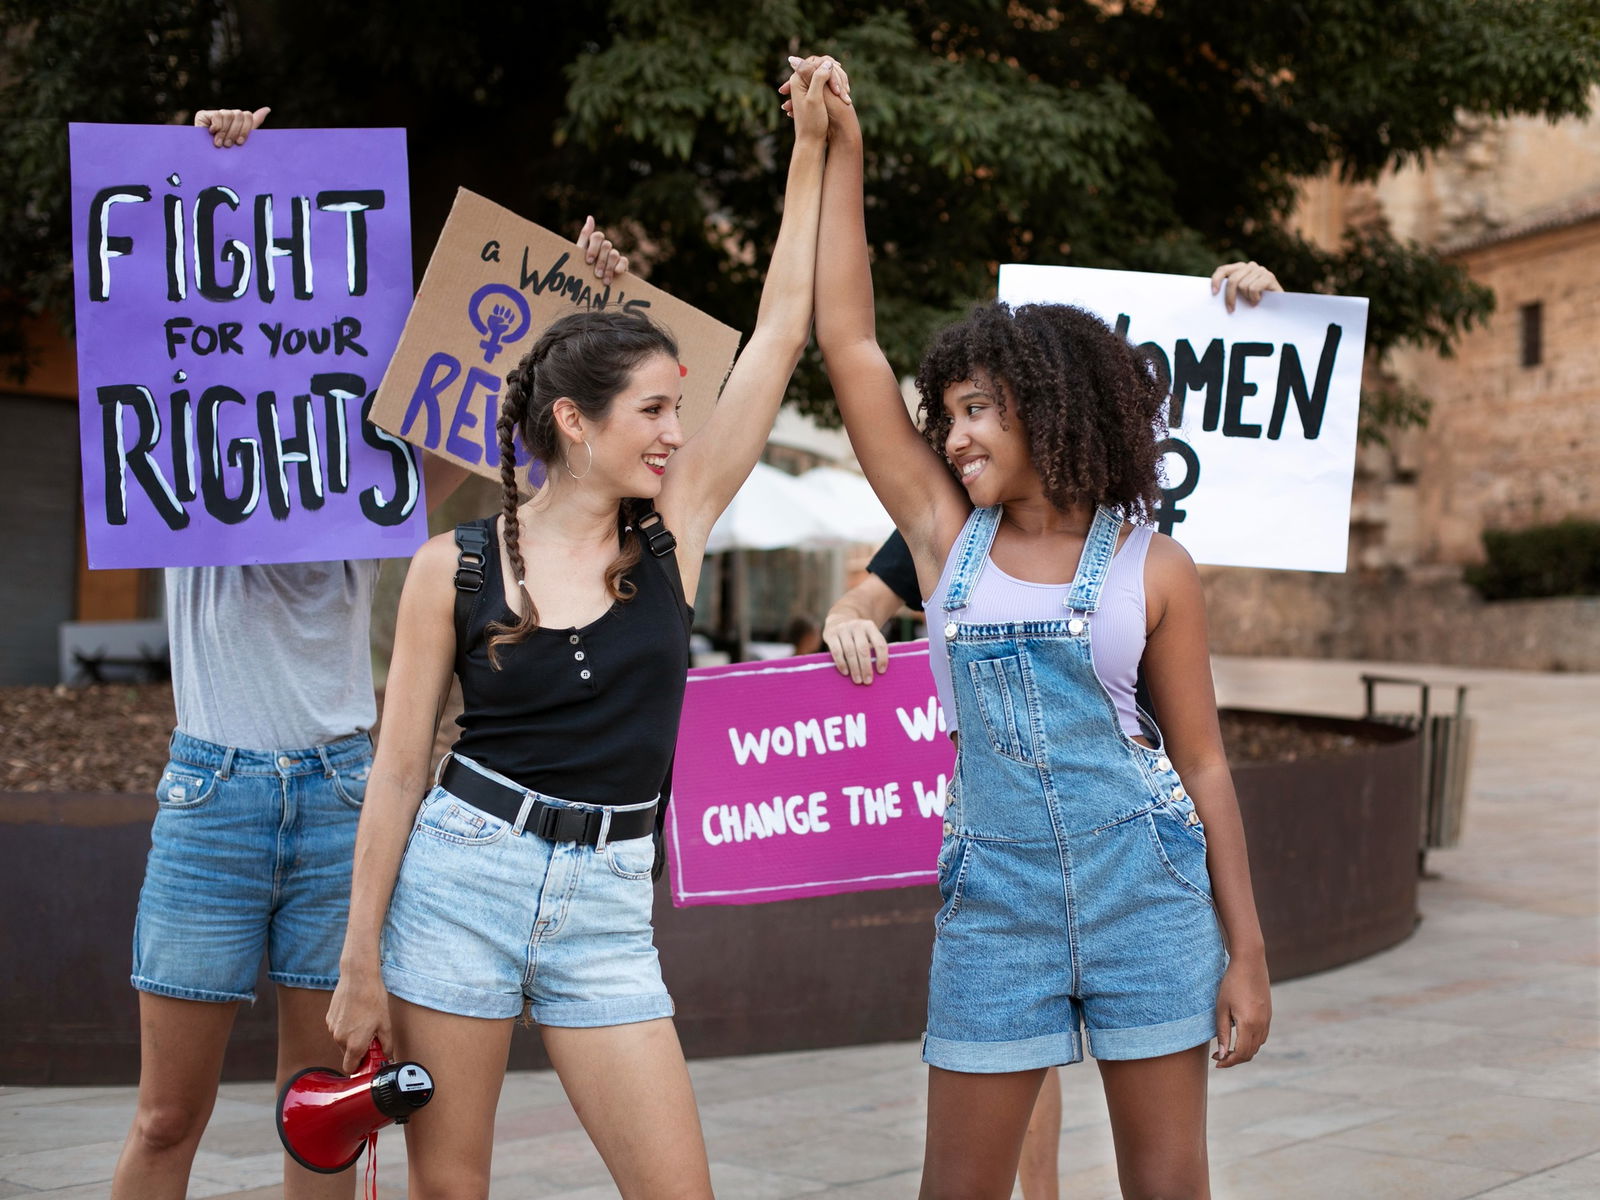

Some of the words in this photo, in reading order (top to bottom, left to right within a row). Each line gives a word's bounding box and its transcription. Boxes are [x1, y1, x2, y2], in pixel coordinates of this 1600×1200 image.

[163, 316, 244, 360] FOR
[258, 315, 368, 359] YOUR
[1114, 312, 1343, 440] OMEN
[728, 712, 867, 766] WOMEN
[702, 791, 831, 846] CHANGE
[841, 782, 903, 826] THE
